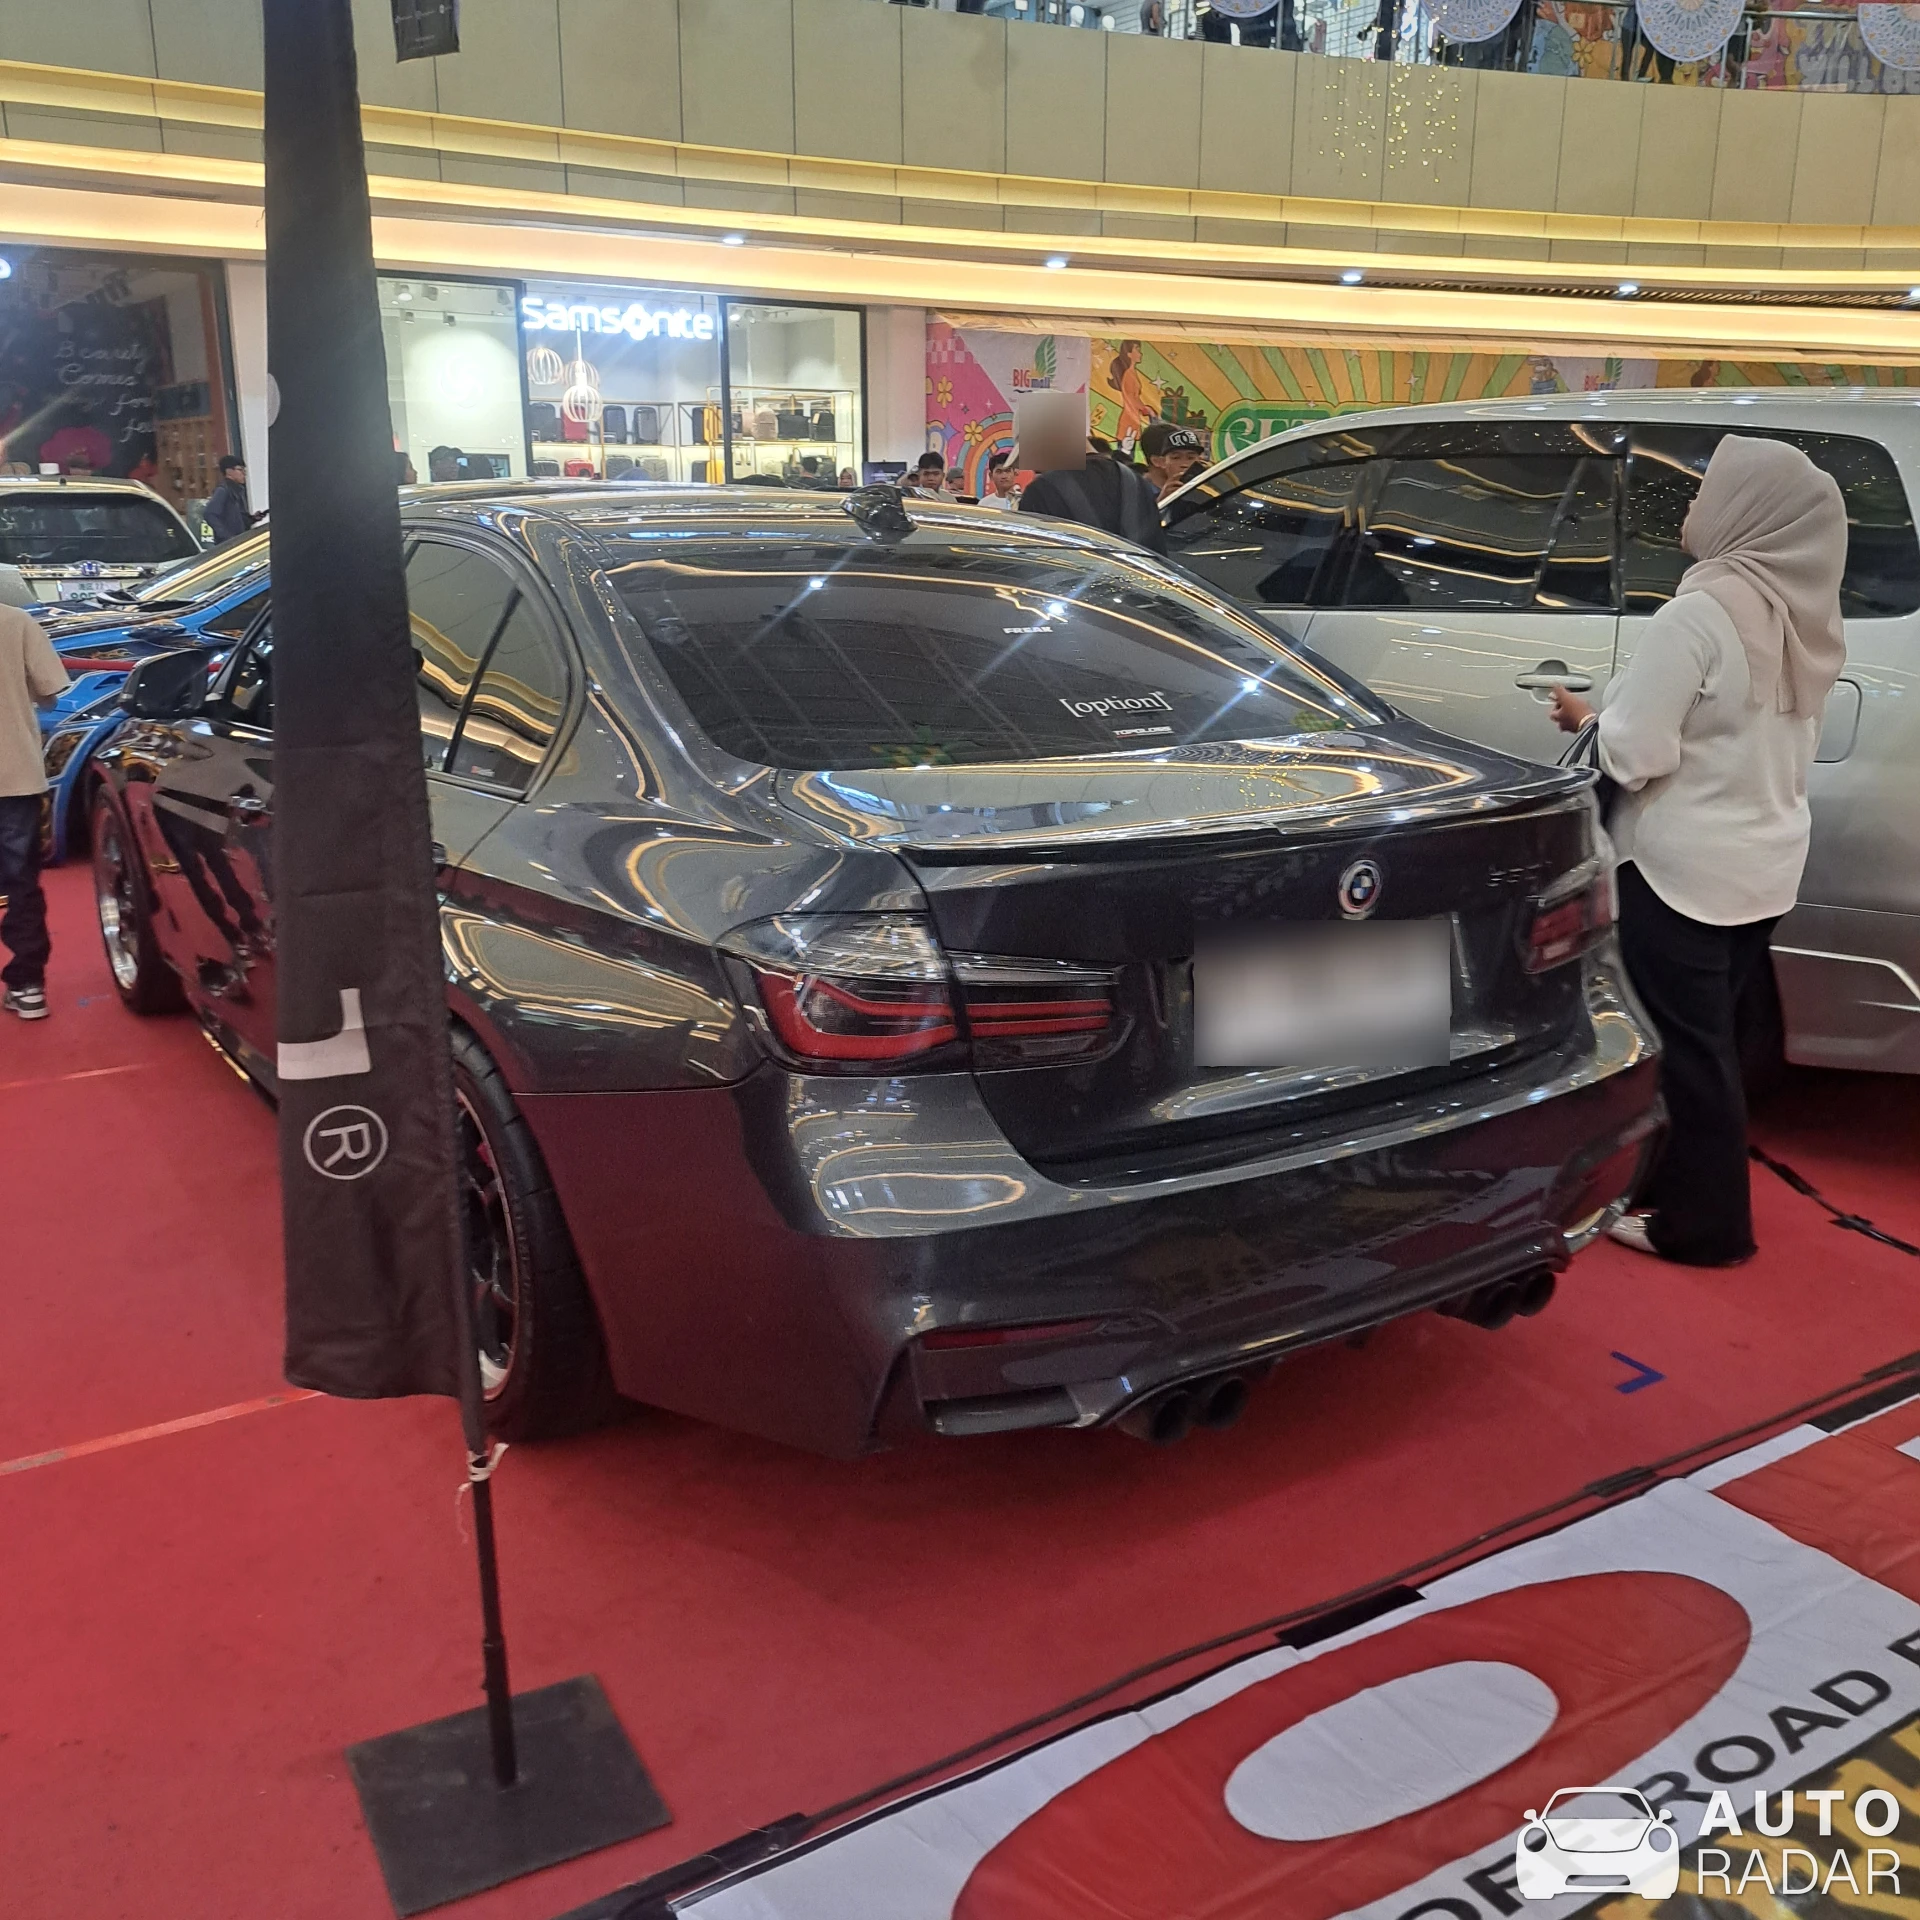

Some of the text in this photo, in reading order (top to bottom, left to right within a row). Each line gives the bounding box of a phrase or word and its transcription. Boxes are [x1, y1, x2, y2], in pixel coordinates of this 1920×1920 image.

[522, 297, 714, 340] Samsonite
[1013, 369, 1030, 388] BIG
[1620, 1669, 1892, 1827] ROAD
